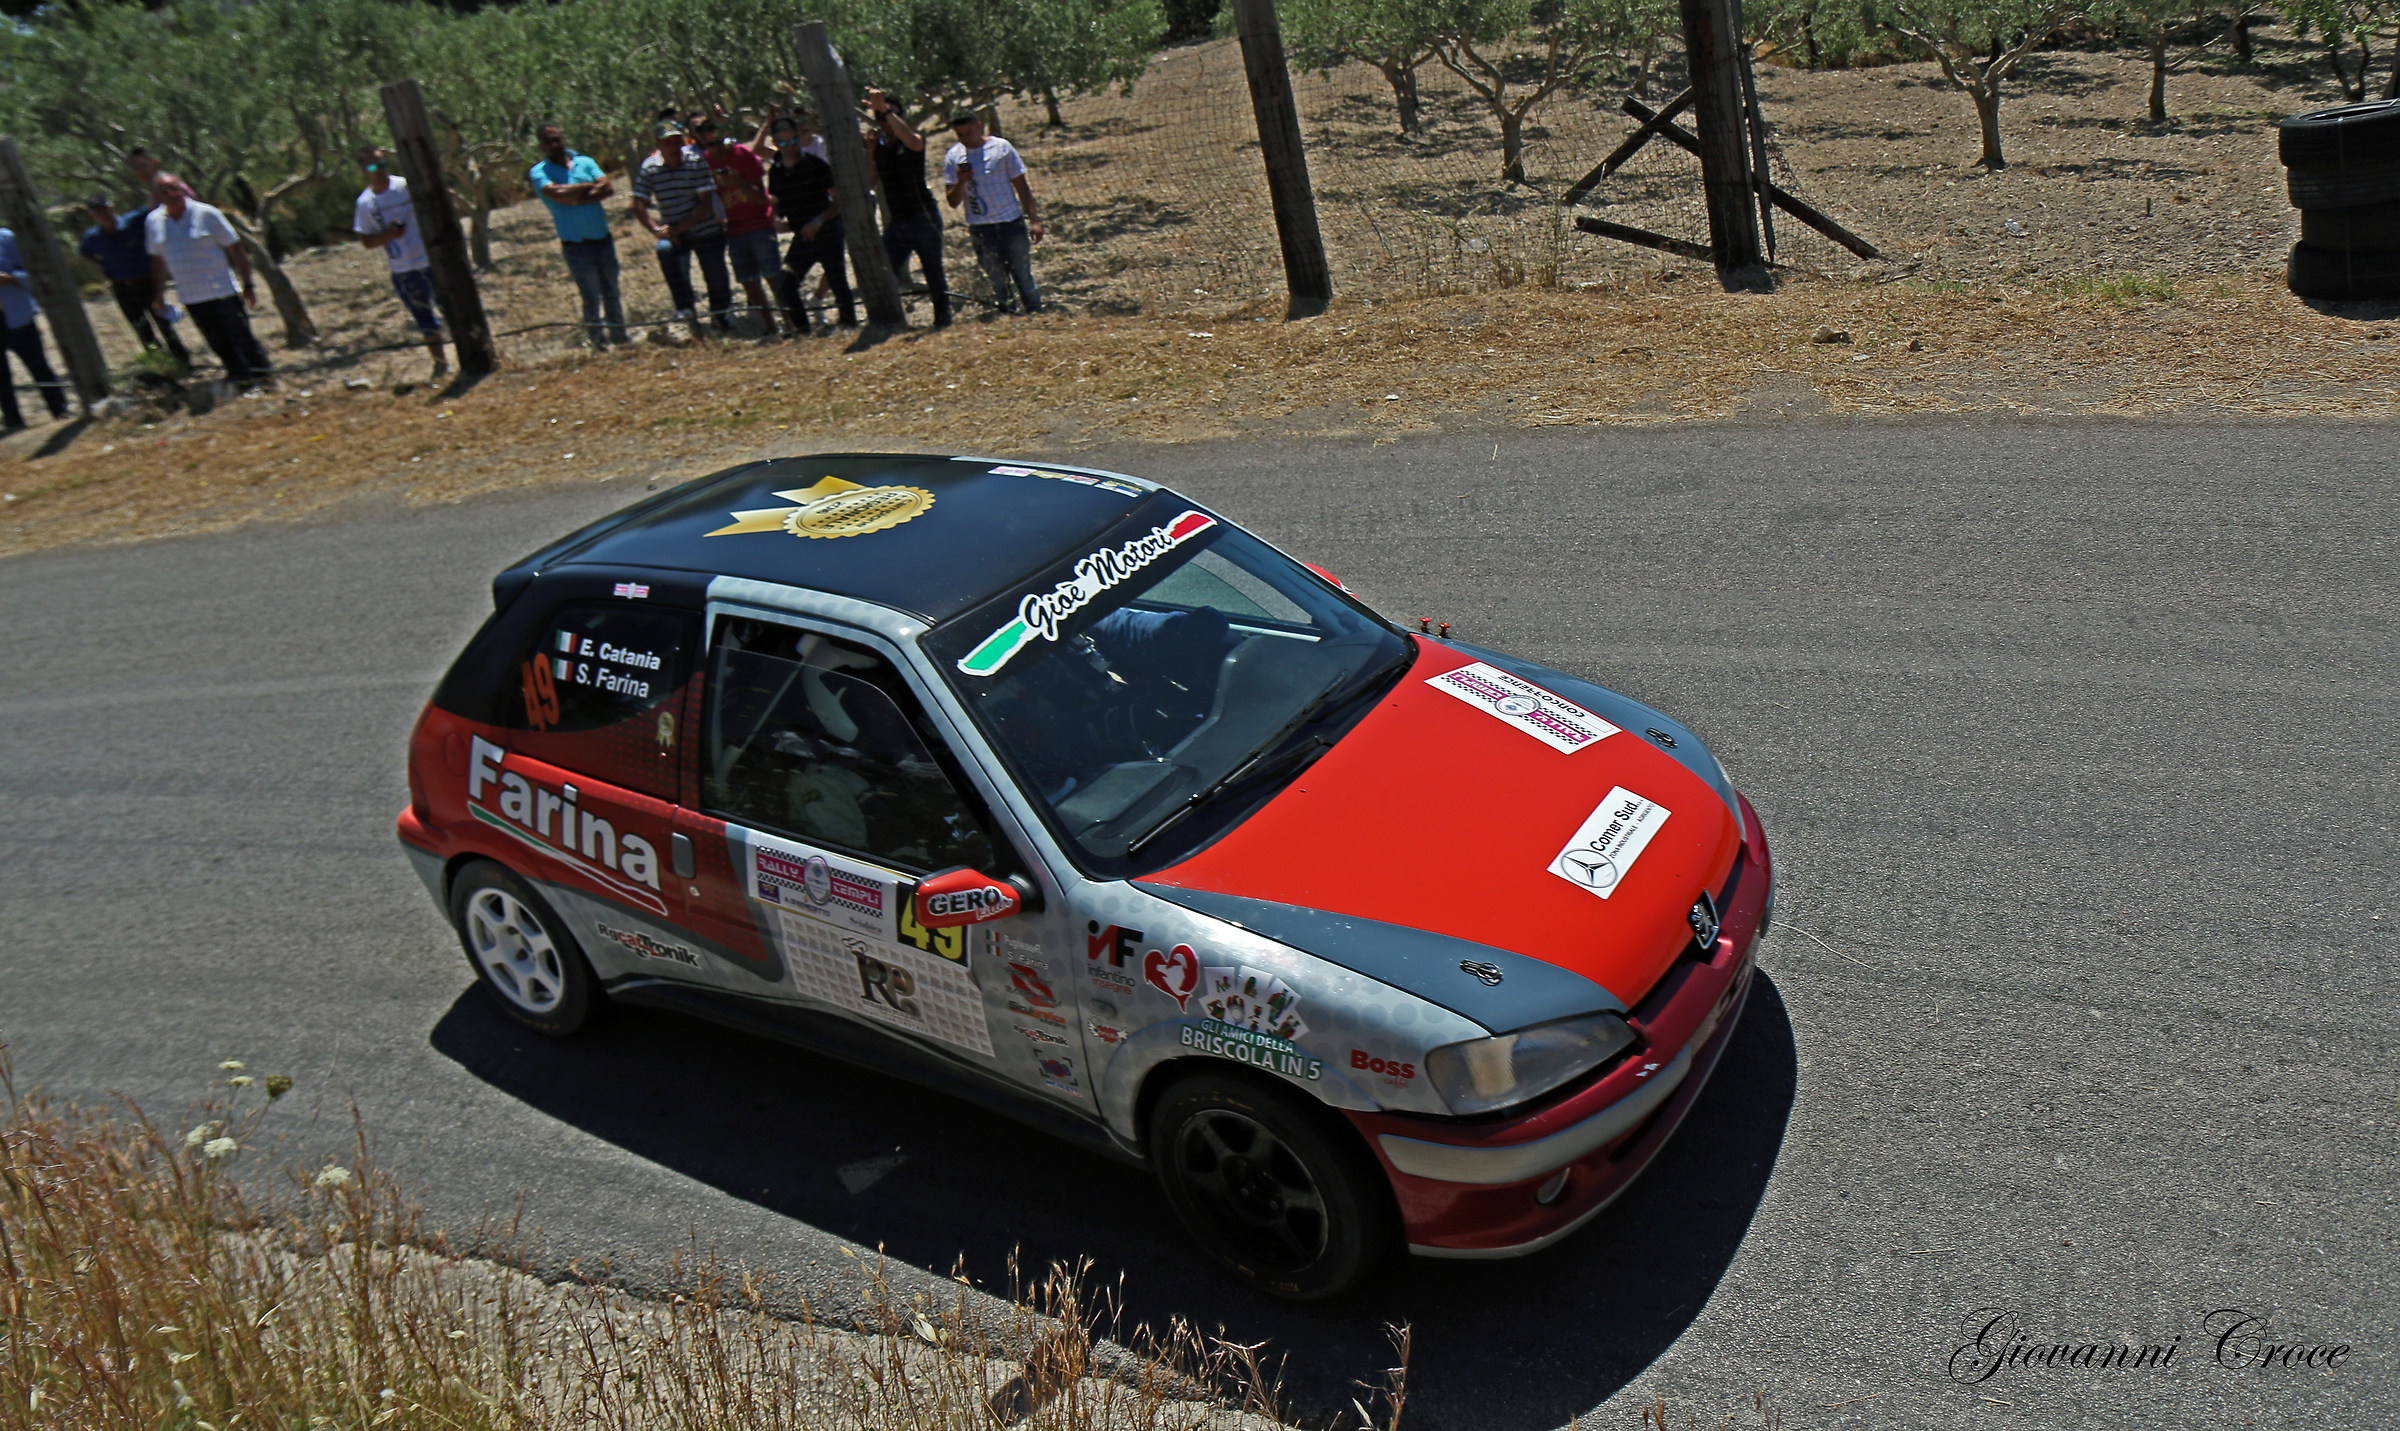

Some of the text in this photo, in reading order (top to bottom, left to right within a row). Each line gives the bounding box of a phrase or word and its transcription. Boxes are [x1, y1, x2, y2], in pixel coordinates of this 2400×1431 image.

[1079, 528, 1172, 587] Motori
[579, 638, 662, 670] E. Catania
[521, 652, 560, 732] 49
[575, 663, 649, 698] S. Farina
[468, 733, 663, 894] Farina
[1590, 819, 1624, 851] Comer
[928, 886, 1002, 916] GERO
[1181, 1025, 1322, 1081] BRISCOLA IN 5
[1221, 1025, 1256, 1044] AMICI
[1256, 1030, 1295, 1052] DELLA
